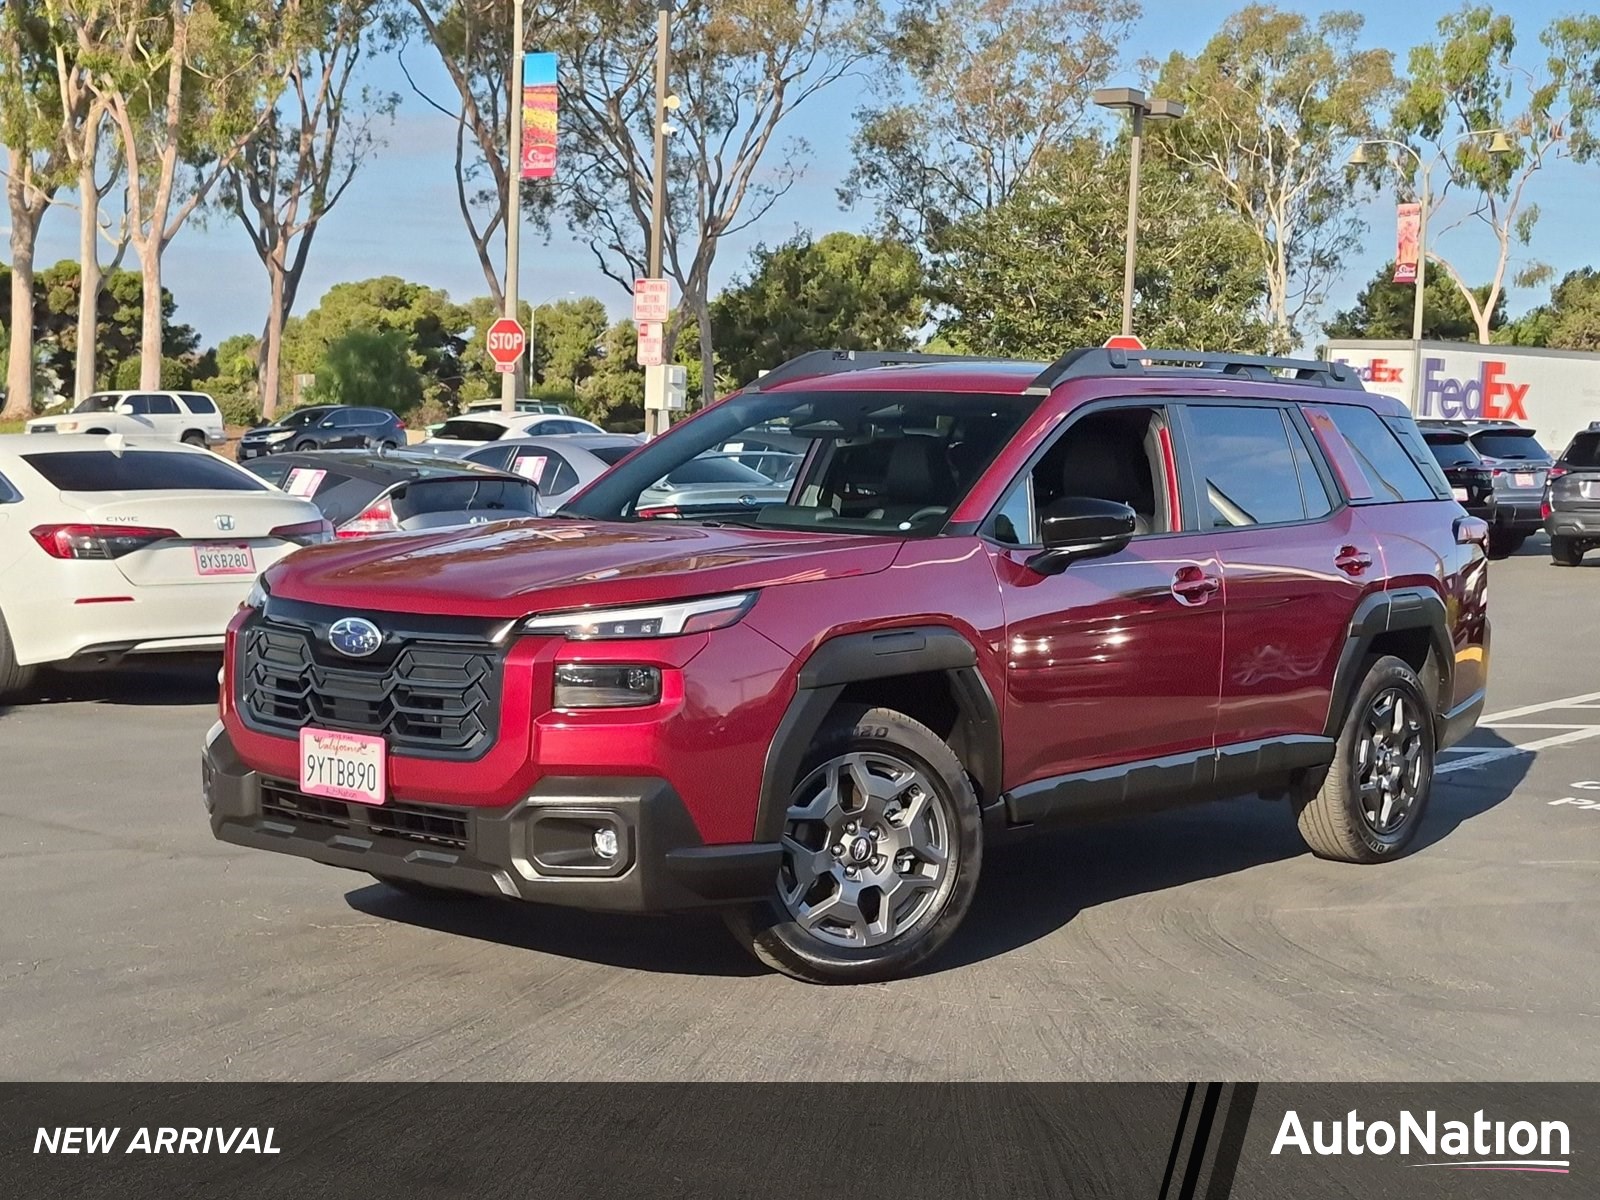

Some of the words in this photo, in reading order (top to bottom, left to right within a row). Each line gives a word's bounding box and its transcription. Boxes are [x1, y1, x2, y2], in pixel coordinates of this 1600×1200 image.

[490, 332, 522, 350] STOP
[1418, 357, 1530, 420] FedEx
[200, 553, 248, 569] 8YSB280
[317, 736, 366, 756] California
[306, 754, 376, 792] 9YTB890
